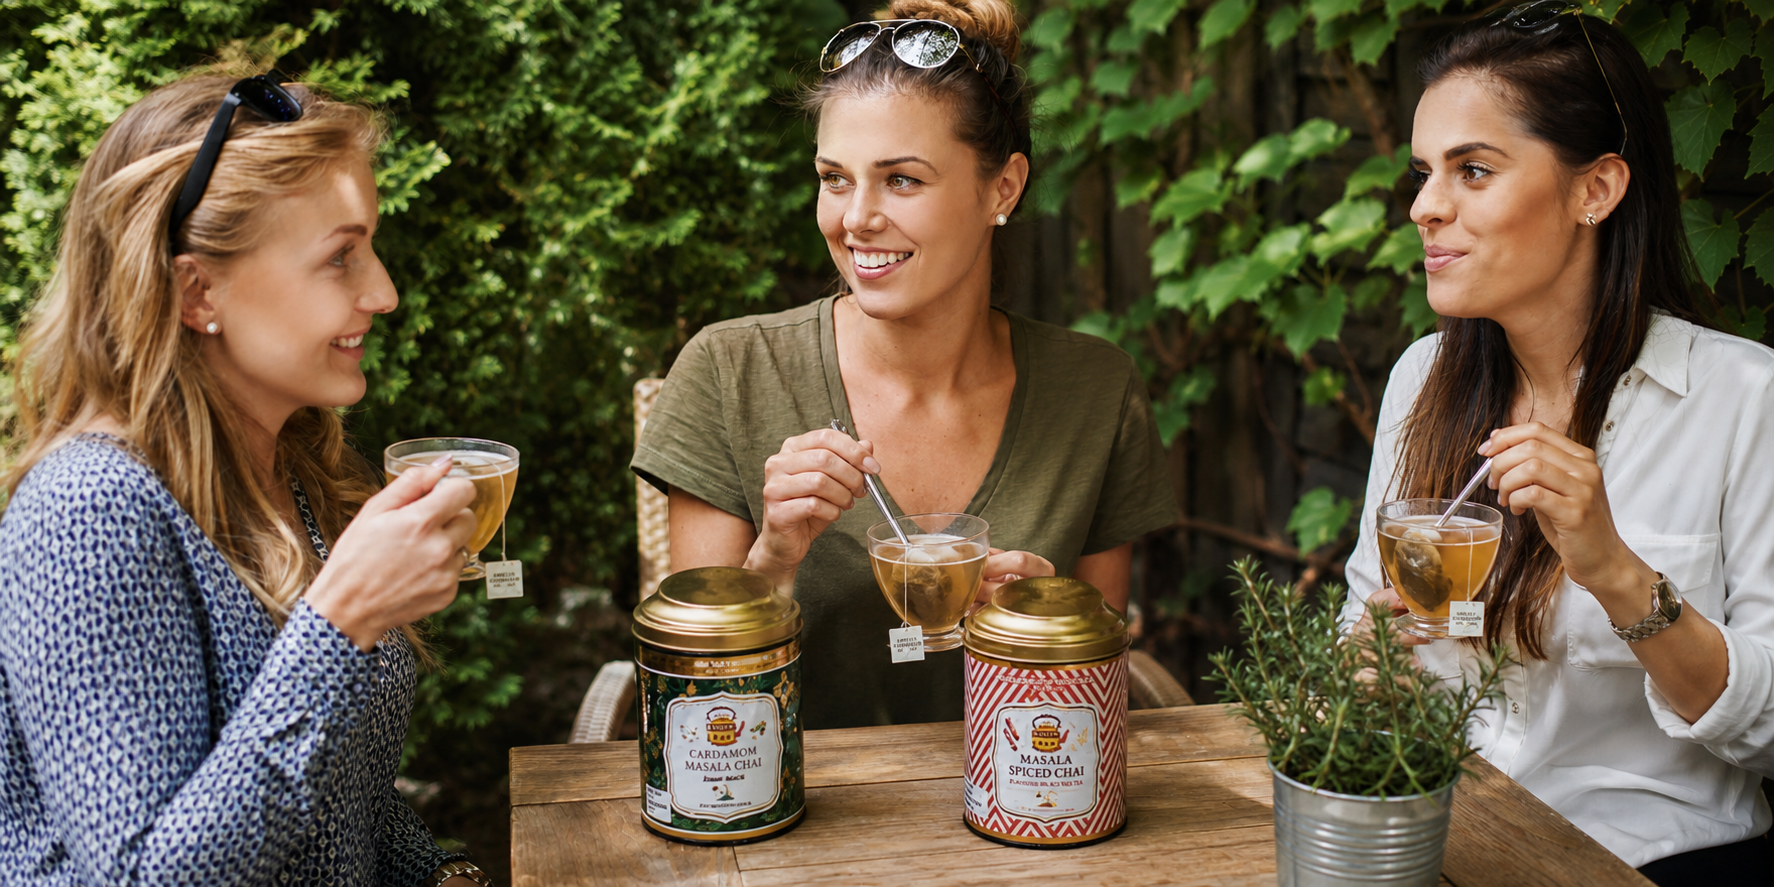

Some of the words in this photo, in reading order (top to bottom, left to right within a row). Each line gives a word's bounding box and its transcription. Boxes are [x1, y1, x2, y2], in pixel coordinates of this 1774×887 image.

[689, 746, 757, 760] CARDAMOM
[1020, 754, 1073, 765] MASALA
[685, 760, 731, 772] MASALA
[734, 757, 762, 771] CHAI
[1008, 765, 1052, 778] SPICED
[1054, 766, 1085, 778] CHAI
